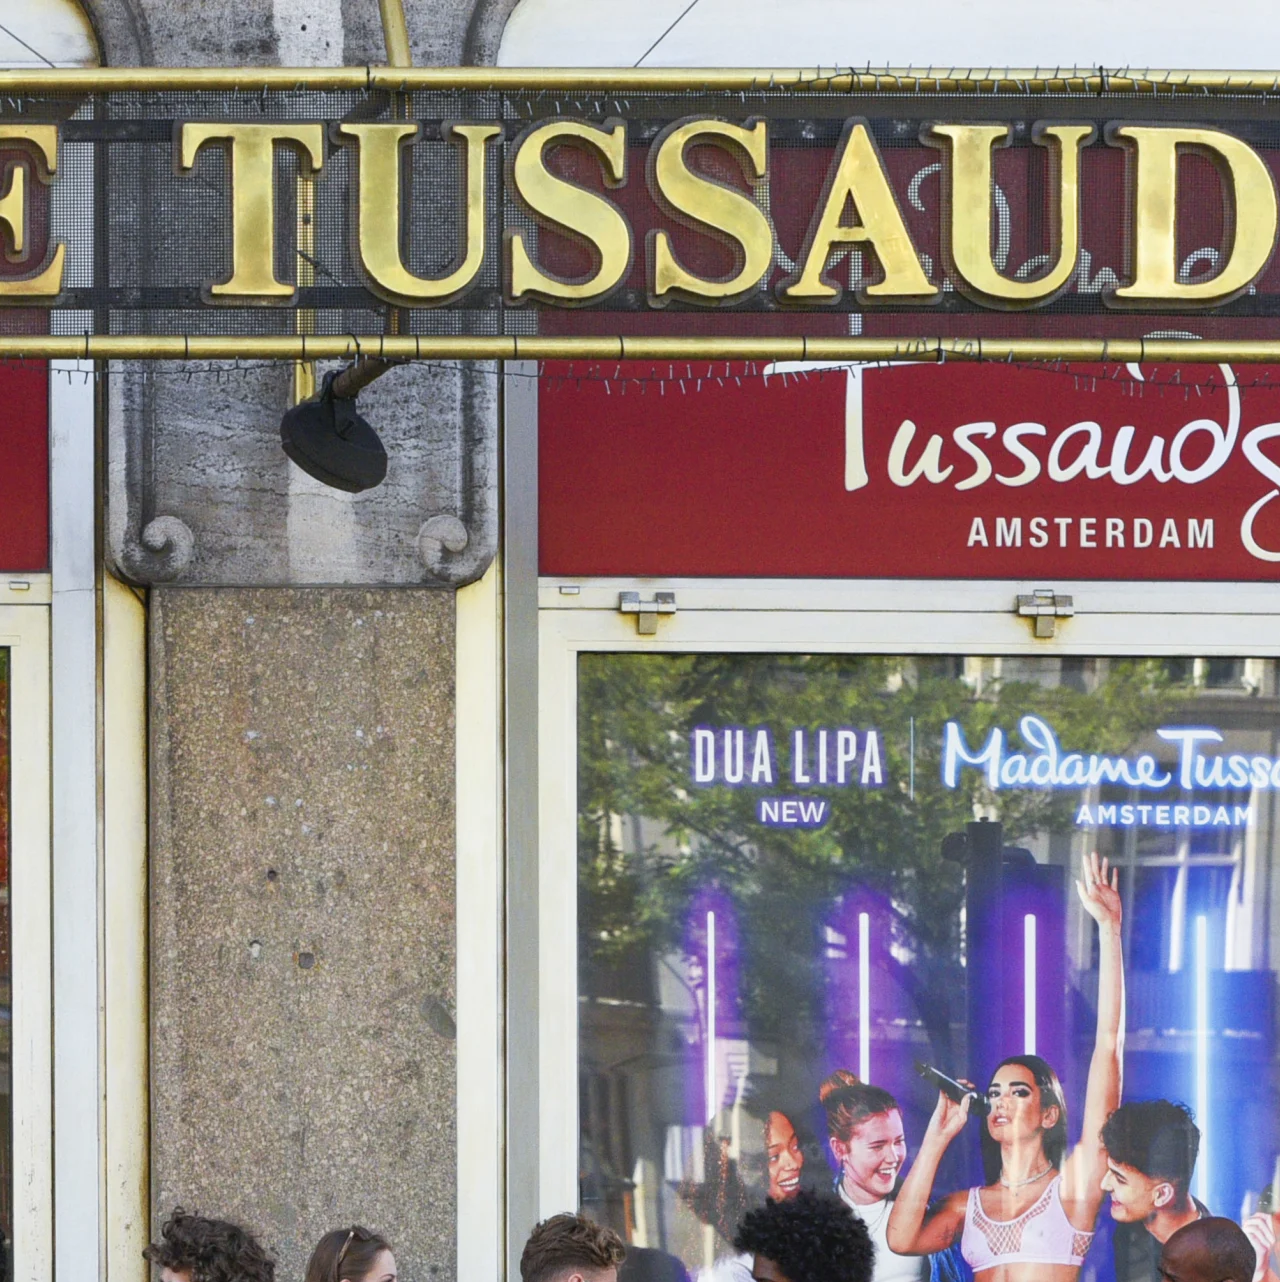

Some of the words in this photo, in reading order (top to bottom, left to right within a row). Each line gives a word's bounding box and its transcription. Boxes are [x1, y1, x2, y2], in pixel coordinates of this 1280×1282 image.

[181, 119, 1279, 302] TUSSAUD
[967, 517, 1216, 549] AMSTERDAM
[694, 729, 773, 784] DUA
[794, 730, 884, 785] LIPA
[943, 715, 1172, 790] Madame
[761, 801, 826, 823] NEW
[1076, 804, 1254, 827] AMSTERDAM
